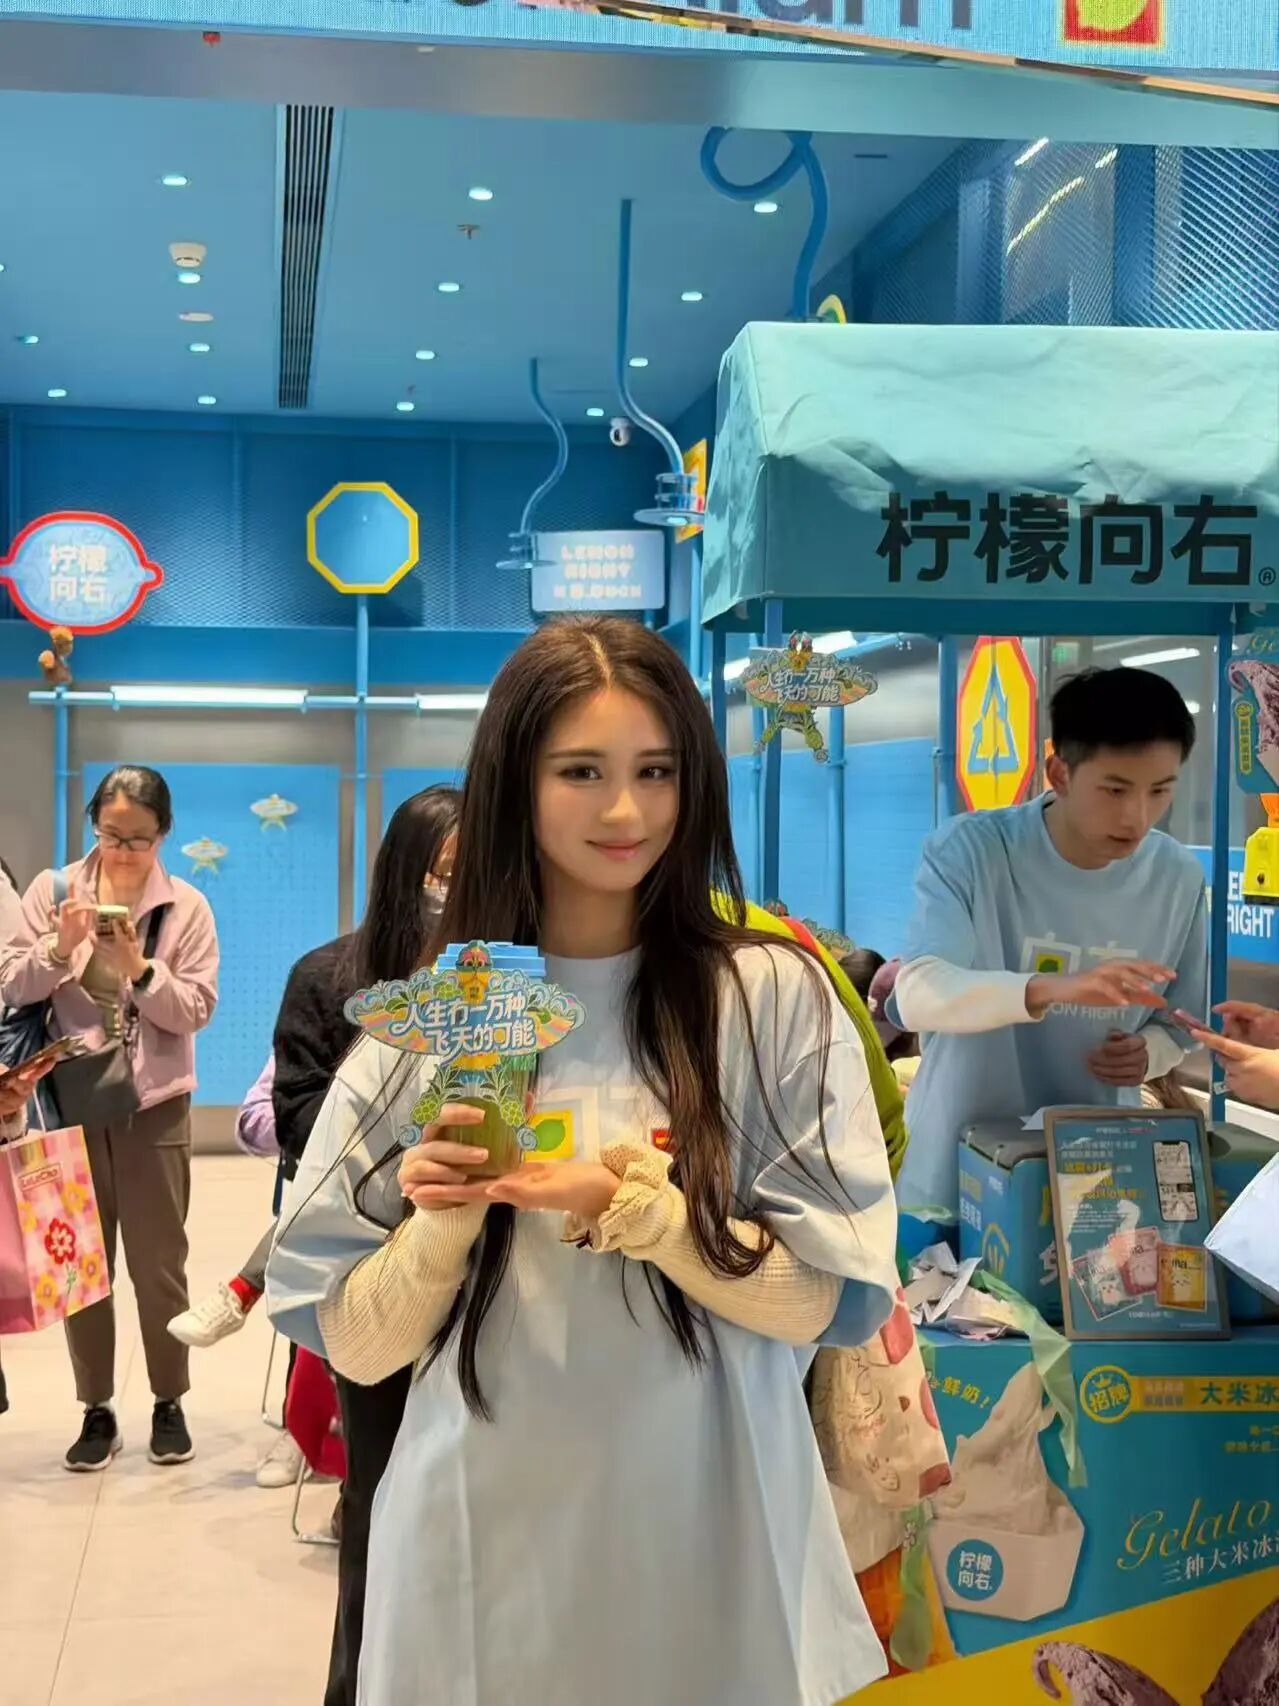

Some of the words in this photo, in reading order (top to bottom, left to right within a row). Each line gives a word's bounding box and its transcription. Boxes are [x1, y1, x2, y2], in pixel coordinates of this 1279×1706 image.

[876, 491, 1258, 586] 柠檬向右
[50, 544, 107, 572] 柠檬
[50, 576, 107, 604] 向右
[1089, 1383, 1129, 1414] 招牌
[1116, 1498, 1271, 1571] Gelato
[959, 1550, 993, 1571] 柠檬
[958, 1570, 993, 1590] 向右
